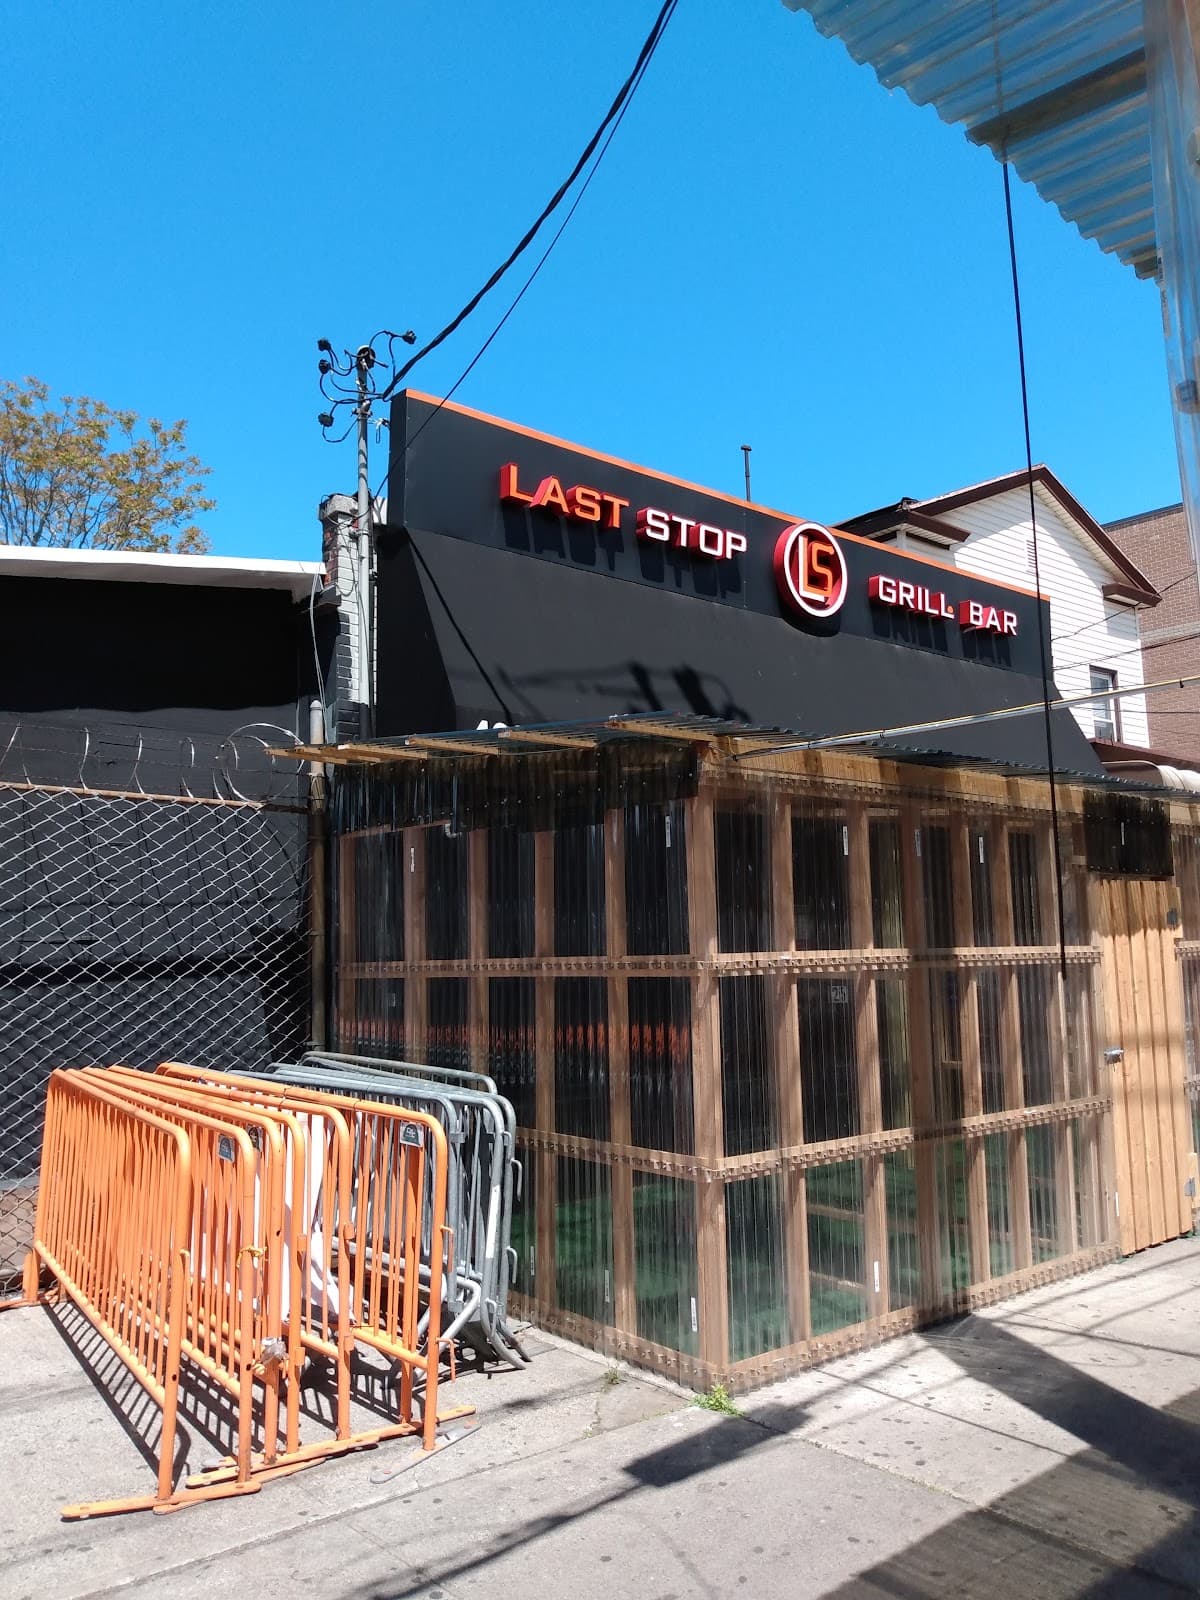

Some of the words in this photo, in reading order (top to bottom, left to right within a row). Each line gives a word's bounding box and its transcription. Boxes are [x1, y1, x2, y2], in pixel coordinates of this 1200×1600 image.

[503, 463, 630, 529] LAST
[641, 508, 748, 560] STOP
[876, 576, 955, 619] GRILL
[966, 601, 1017, 636] BAR
